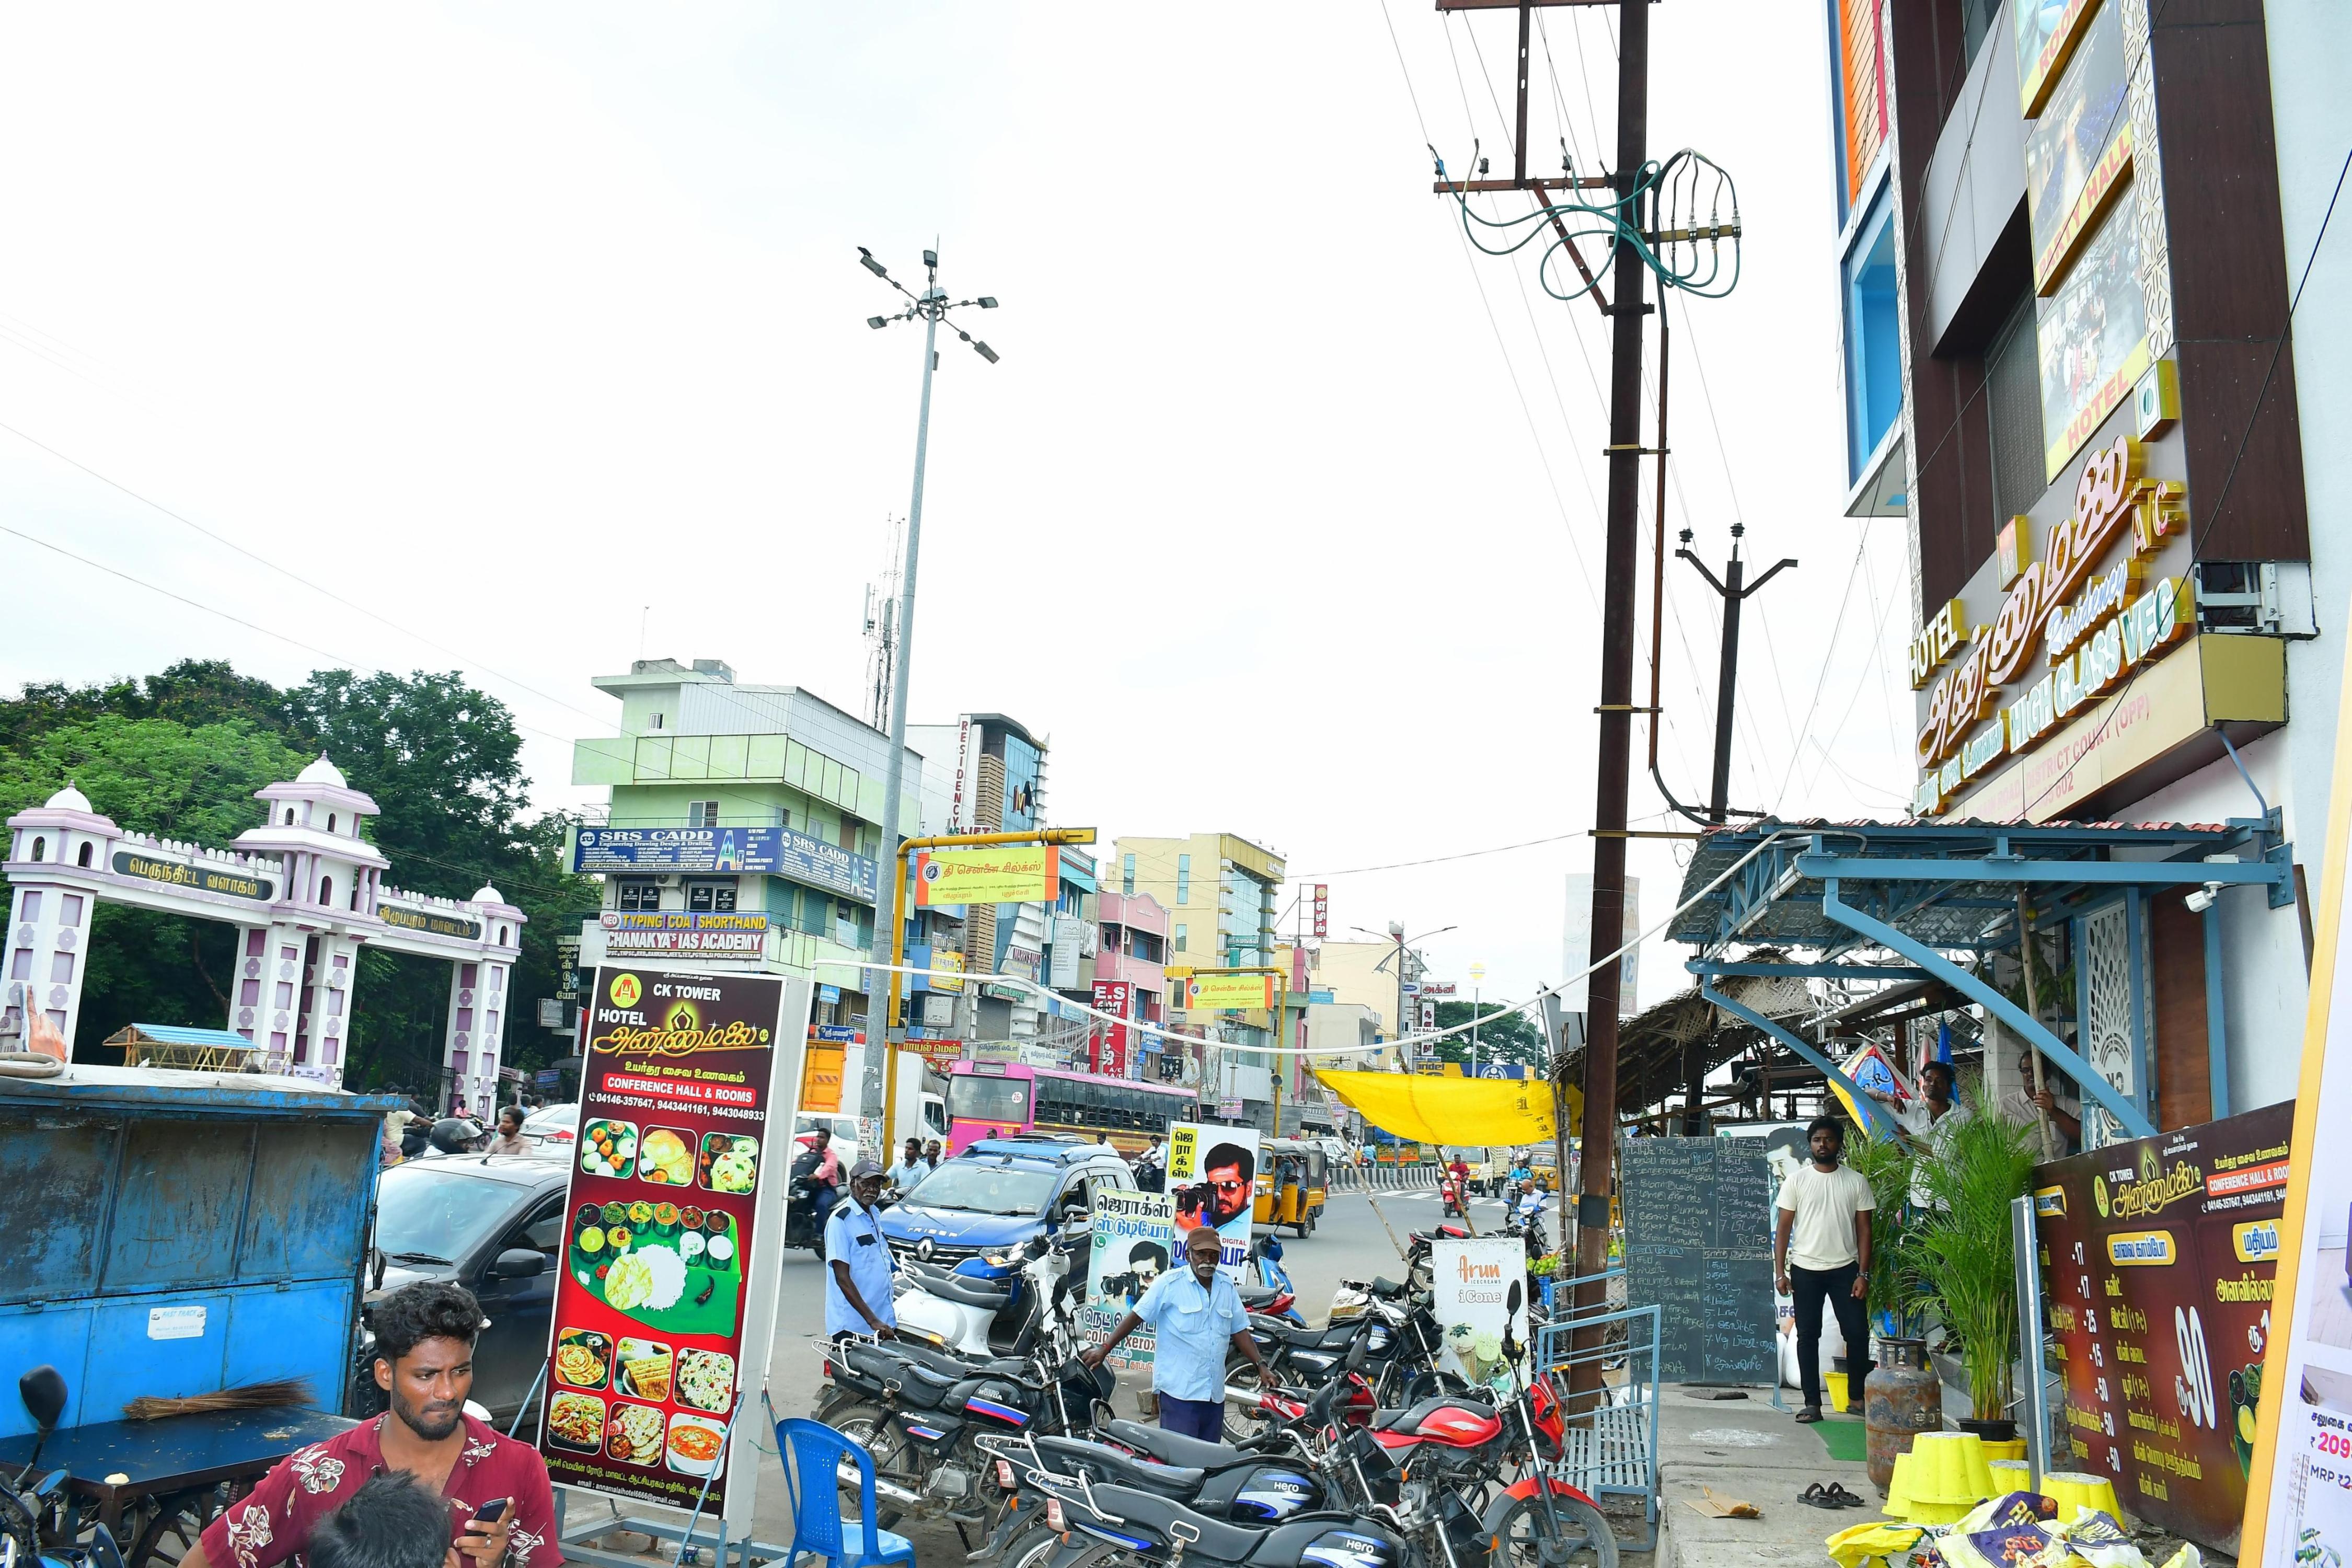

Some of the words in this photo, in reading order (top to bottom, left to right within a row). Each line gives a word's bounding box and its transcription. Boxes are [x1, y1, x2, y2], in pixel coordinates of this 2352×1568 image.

[2038, 204, 2081, 278] PARTY
[2086, 132, 2131, 209] HALL
[2067, 369, 2130, 453] HOTEL
[2045, 558, 2128, 666] Residency
[1909, 599, 1958, 690] HOTEL
[2008, 672, 2054, 754] HIGH
[2054, 619, 2120, 717] CLASS
[2118, 577, 2174, 665] VEG
[2026, 745, 2070, 791] DISTRICT
[2073, 723, 2111, 762] COURT
[2115, 693, 2150, 737] (OPP)
[952, 721, 968, 826] RESIDENCY
[599, 832, 642, 840] SRS
[651, 831, 713, 840] CADD
[793, 836, 815, 851] SRS
[820, 845, 849, 863] CADD
[130, 858, 199, 885] பெருந்திட்ட
[207, 873, 257, 895] வளாகம்
[943, 864, 953, 878] தி
[958, 863, 999, 874] சென்னை
[1002, 861, 1041, 872] சில்க்ஸ்
[1002, 889, 1029, 897] புதுச்சேரி
[379, 906, 426, 928] விழுப்புரம்
[603, 916, 617, 925] NEO
[623, 915, 663, 928] TYPING
[668, 916, 690, 929] COA
[698, 916, 767, 930] SHORTHAND
[1316, 901, 1327, 934] எழில்
[607, 931, 676, 949] CHANAKYA'S
[678, 933, 699, 949] IAS
[700, 933, 762, 951] ACADEMY
[653, 984, 671, 998] CK
[675, 985, 721, 1001] TOWER
[1094, 986, 1125, 1000] E.S
[1423, 984, 1456, 994] அக்னி
[598, 1008, 648, 1026] HOTEL
[904, 1042, 931, 1052] ராயல்
[934, 1043, 960, 1054] மெஸ்
[625, 1061, 660, 1076] உயர்தர
[662, 1067, 693, 1078] சைவ
[694, 1067, 745, 1083] உணவகம்
[607, 1077, 674, 1094] CONFERENCE
[676, 1085, 701, 1098] HALL
[705, 1088, 712, 1099] &
[715, 1088, 753, 1103] ROOMS
[596, 1093, 655, 1111] 04146-357647,
[657, 1101, 710, 1116] 9443441161,
[712, 1106, 765, 1121] 9443048933
[1172, 1131, 1193, 1179] ஜெராக்ஸ்
[2215, 1155, 2236, 1169] உயர்தர
[2237, 1152, 2255, 1165] சைவ
[2256, 1140, 2288, 1161] உணவகம்
[2109, 1171, 2117, 1183] CK
[2117, 1168, 2134, 1181] TOWER
[2209, 1173, 2248, 1192] CONFERENCE
[2249, 1172, 2266, 1186] HALL
[2267, 1169, 2273, 1180] &
[1098, 1195, 1172, 1218] ஜெராக்ஸ்
[1096, 1213, 1170, 1239] ஸ்டுடியோ
[1222, 1238, 1247, 1246] DIGITAL
[2113, 1241, 2135, 1260] காலை
[2136, 1236, 2166, 1258] காம்போ
[2243, 1223, 2278, 1261] மதியம்
[1458, 1255, 1500, 1283] Arun
[1459, 1290, 1502, 1304] iCone
[1085, 1308, 1111, 1328] நெட்
[2111, 1304, 2128, 1329] இட்லி
[1125, 1336, 1156, 1351] xerox
[2116, 1339, 2128, 1362] மினி
[2129, 1345, 2147, 1364] வடை
[978, 1389, 1003, 1401] HONDA
[2311, 1411, 2345, 1430] சலுகை
[2318, 1432, 2352, 1459] 209
[562, 1460, 585, 1473] மெயின்
[586, 1463, 604, 1478] ரோடு,
[605, 1469, 627, 1482] மாவட்ட
[629, 1472, 665, 1490] ஆட்சியரகம்
[666, 1481, 687, 1495] எதிரில்,
[2310, 1464, 2335, 1483] MRP
[595, 1483, 681, 1507] annamalaihotel6666@gmail.com
